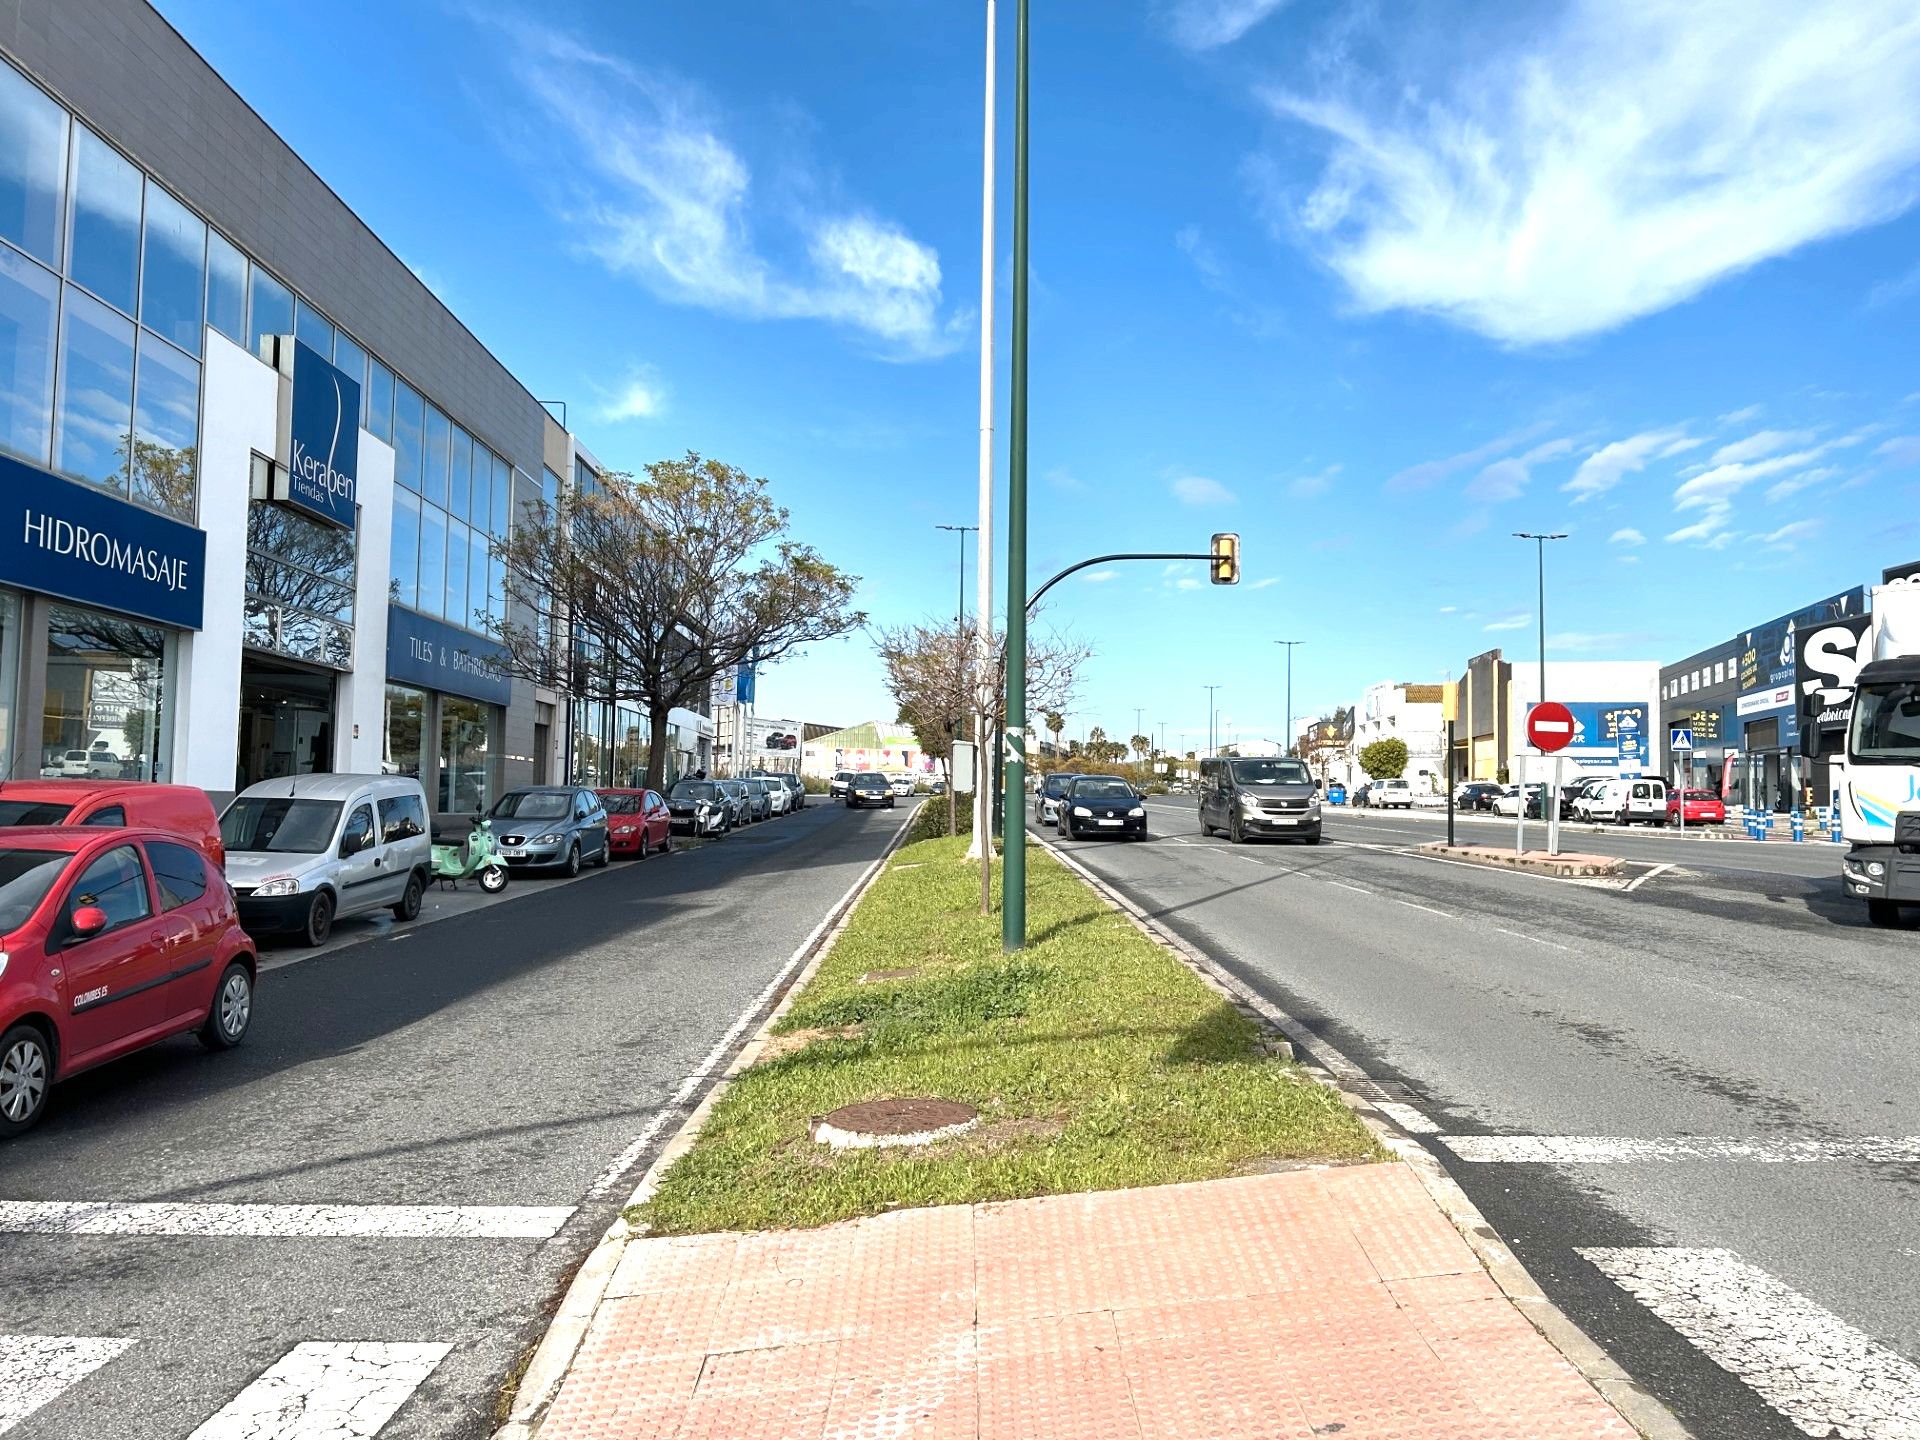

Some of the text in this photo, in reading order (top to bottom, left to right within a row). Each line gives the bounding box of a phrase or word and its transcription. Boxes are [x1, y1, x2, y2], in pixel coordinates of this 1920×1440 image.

[292, 438, 354, 502] Keraben
[292, 475, 325, 504] Tiendas
[24, 509, 188, 592] HIDROMASAJE
[409, 636, 433, 663] TILES
[439, 646, 448, 668] &
[1901, 773, 1920, 803] J
